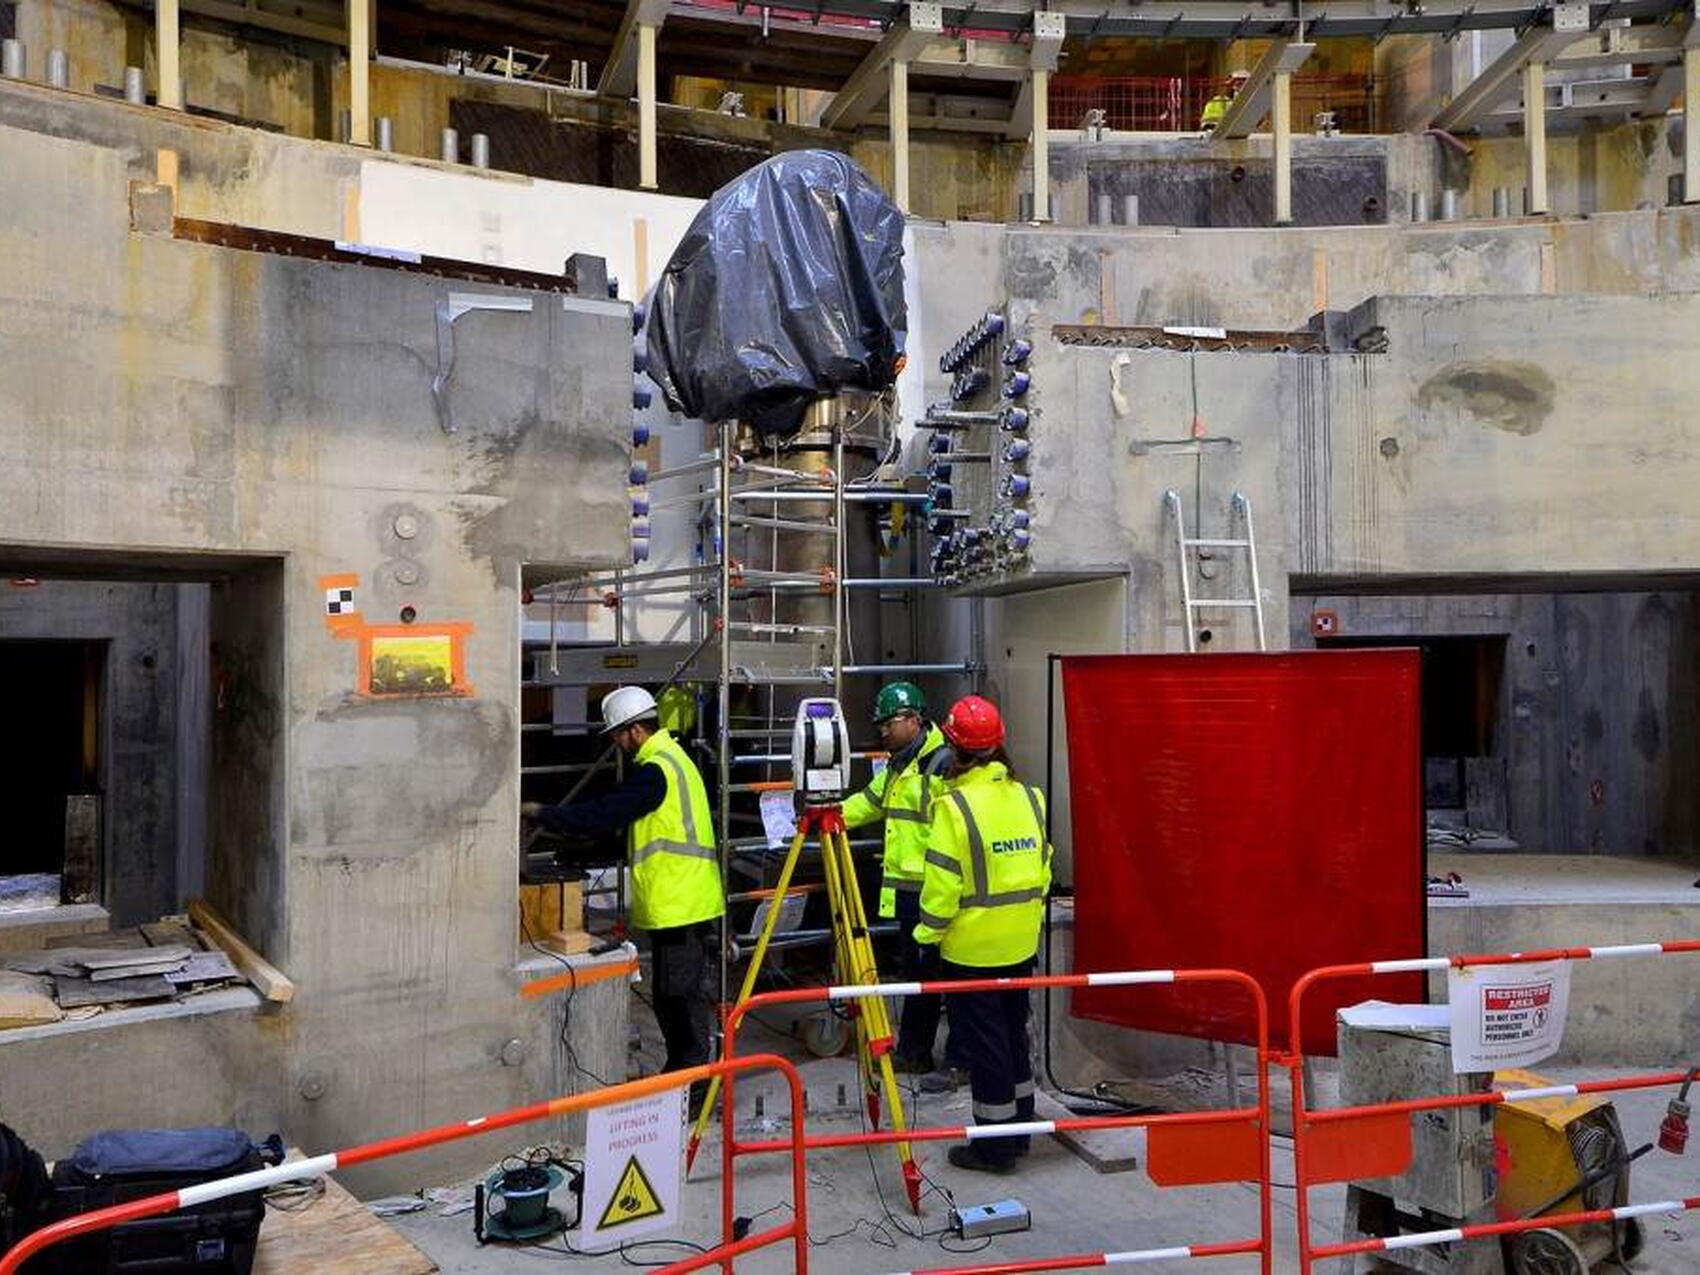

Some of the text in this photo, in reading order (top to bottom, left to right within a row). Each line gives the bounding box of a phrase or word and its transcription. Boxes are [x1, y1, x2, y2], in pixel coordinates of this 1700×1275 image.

[992, 838, 1036, 853] CNIM
[1488, 987, 1549, 999] RESTRICTED
[1508, 998, 1534, 1008] AREA
[609, 1113, 659, 1134] LIFTING IN
[609, 1132, 658, 1152] PROGRESS
